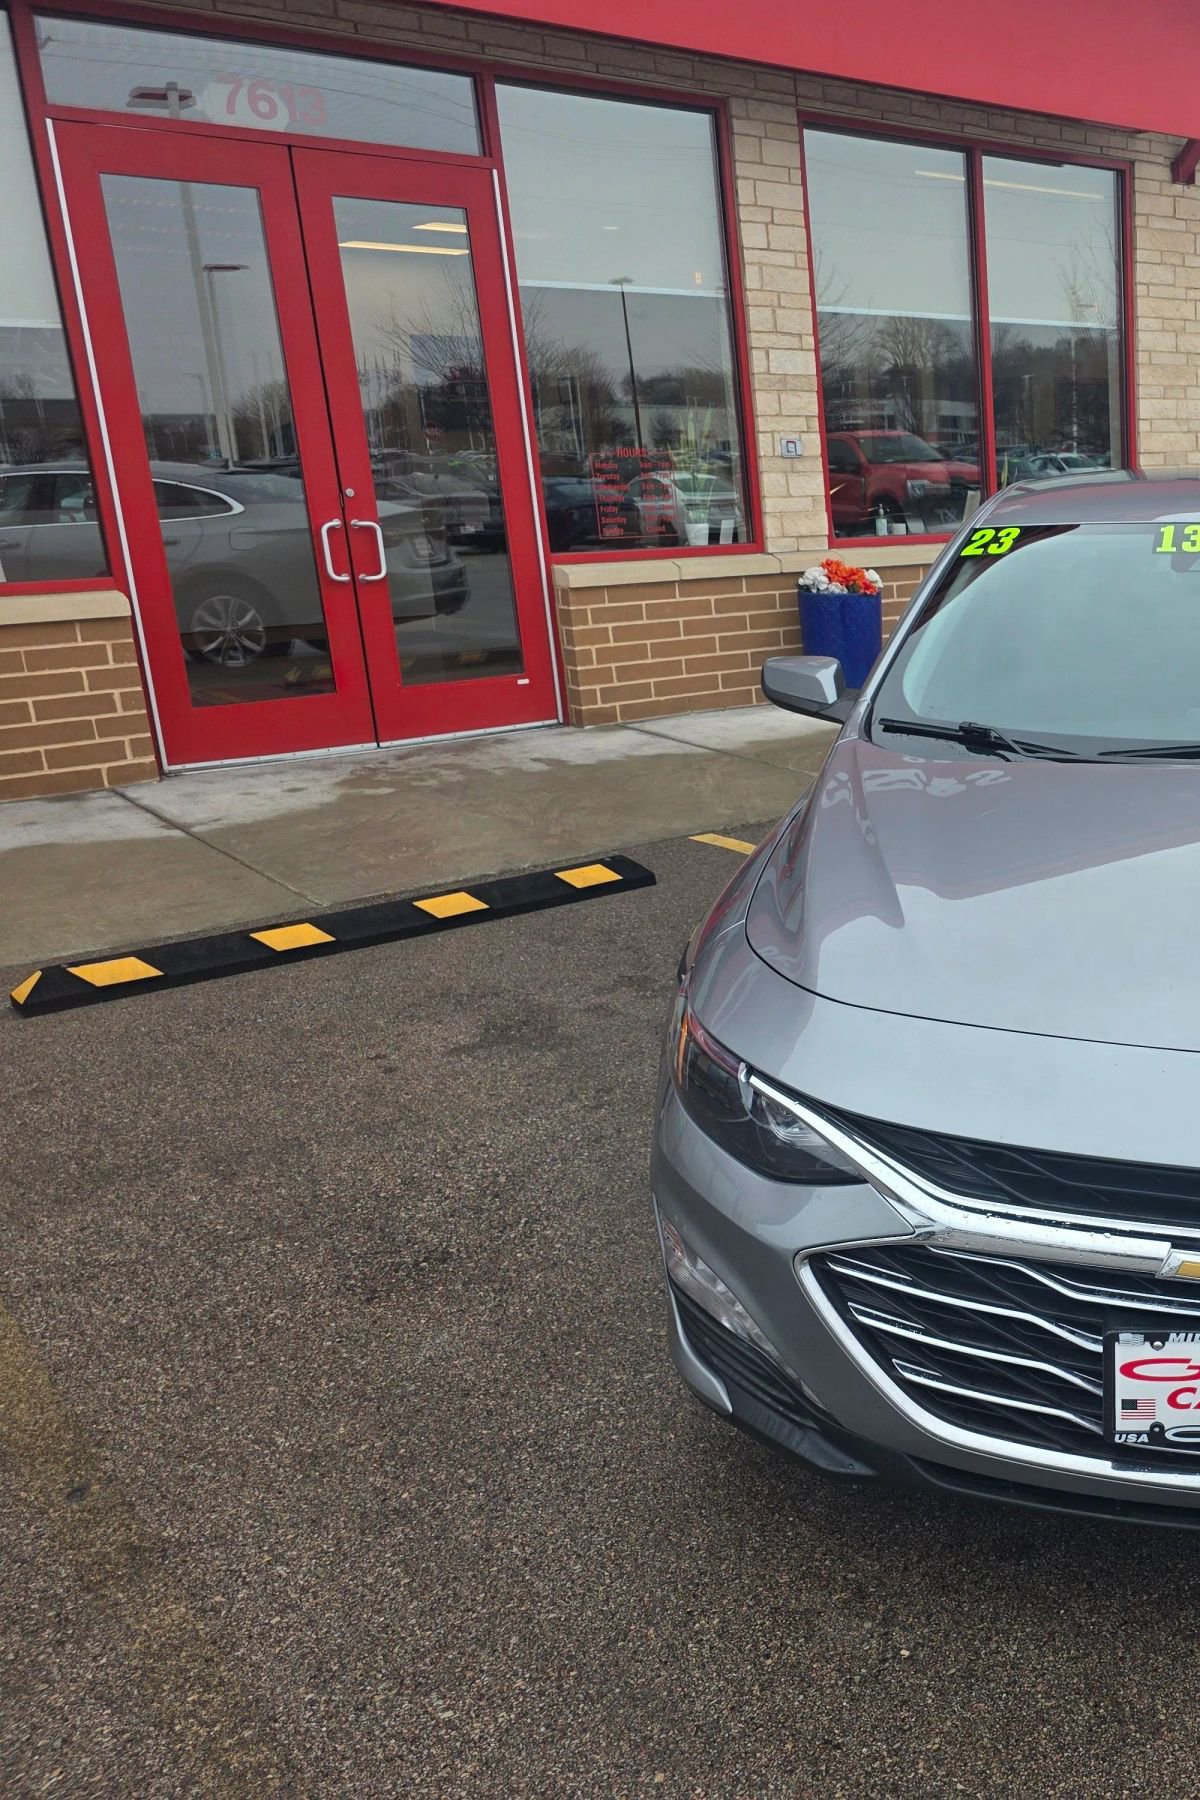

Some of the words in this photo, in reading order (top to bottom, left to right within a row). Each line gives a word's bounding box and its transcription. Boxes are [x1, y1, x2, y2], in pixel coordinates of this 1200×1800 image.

[215, 73, 329, 126] 7613
[616, 448, 647, 457] HOURS
[600, 505, 618, 514] Friday
[960, 527, 1021, 556] 23
[1114, 1433, 1149, 1443] USA
